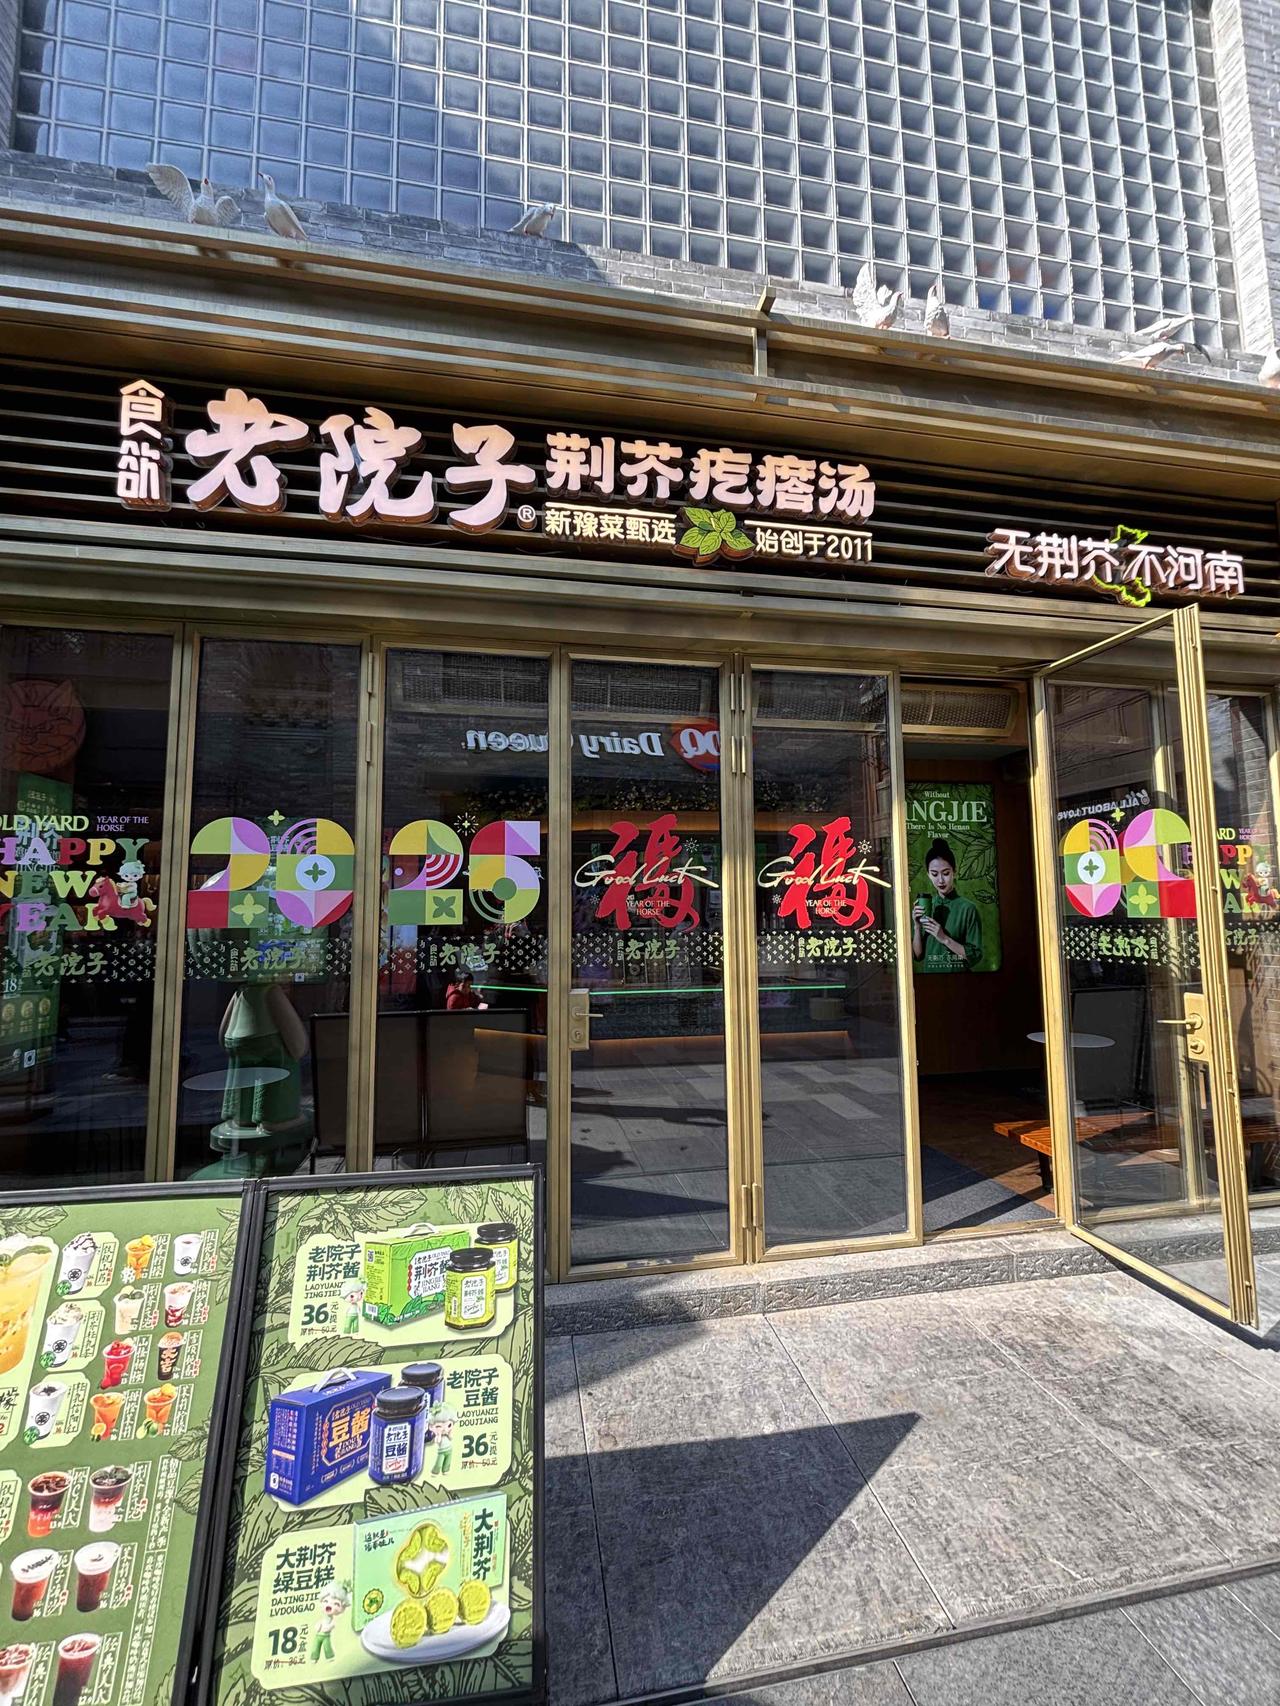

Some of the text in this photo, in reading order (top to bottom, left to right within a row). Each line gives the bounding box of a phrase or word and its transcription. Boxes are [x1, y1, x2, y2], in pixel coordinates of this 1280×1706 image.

[185, 388, 536, 526] 老院子
[546, 432, 876, 517] 荆芥疙瘩汤
[545, 509, 677, 545] 新豫菜甄选
[756, 528, 873, 562] 始创于2011
[924, 790, 950, 798] Without
[0, 815, 89, 831] LD YARD
[96, 815, 149, 824] YEAR OF THE
[96, 824, 125, 832] HORSE
[574, 854, 720, 889] Good Luck
[757, 856, 892, 889] Good Luck
[626, 900, 671, 908] YEAR OF THE
[636, 908, 661, 916] HORSE
[805, 899, 821, 907] YEAR
[815, 907, 838, 915] HORSE
[806, 936, 857, 957] 老院子
[308, 1243, 362, 1262] 老院子
[306, 1261, 361, 1282] 荆芥酱
[301, 1302, 330, 1326] 36
[446, 1367, 500, 1389] 老院子
[463, 1387, 499, 1408] 豆酱
[329, 1407, 371, 1448] 豆酱
[460, 1416, 499, 1428] DOUJIANG
[461, 1433, 489, 1458] 36
[472, 1507, 494, 1582] 大荆芥
[276, 1541, 337, 1571] 大荆芥
[272, 1564, 336, 1595] 绿豆糕
[271, 1591, 321, 1608] DAJINGJIE
[269, 1603, 316, 1618] LVDOUGAO
[268, 1626, 298, 1656] 18
